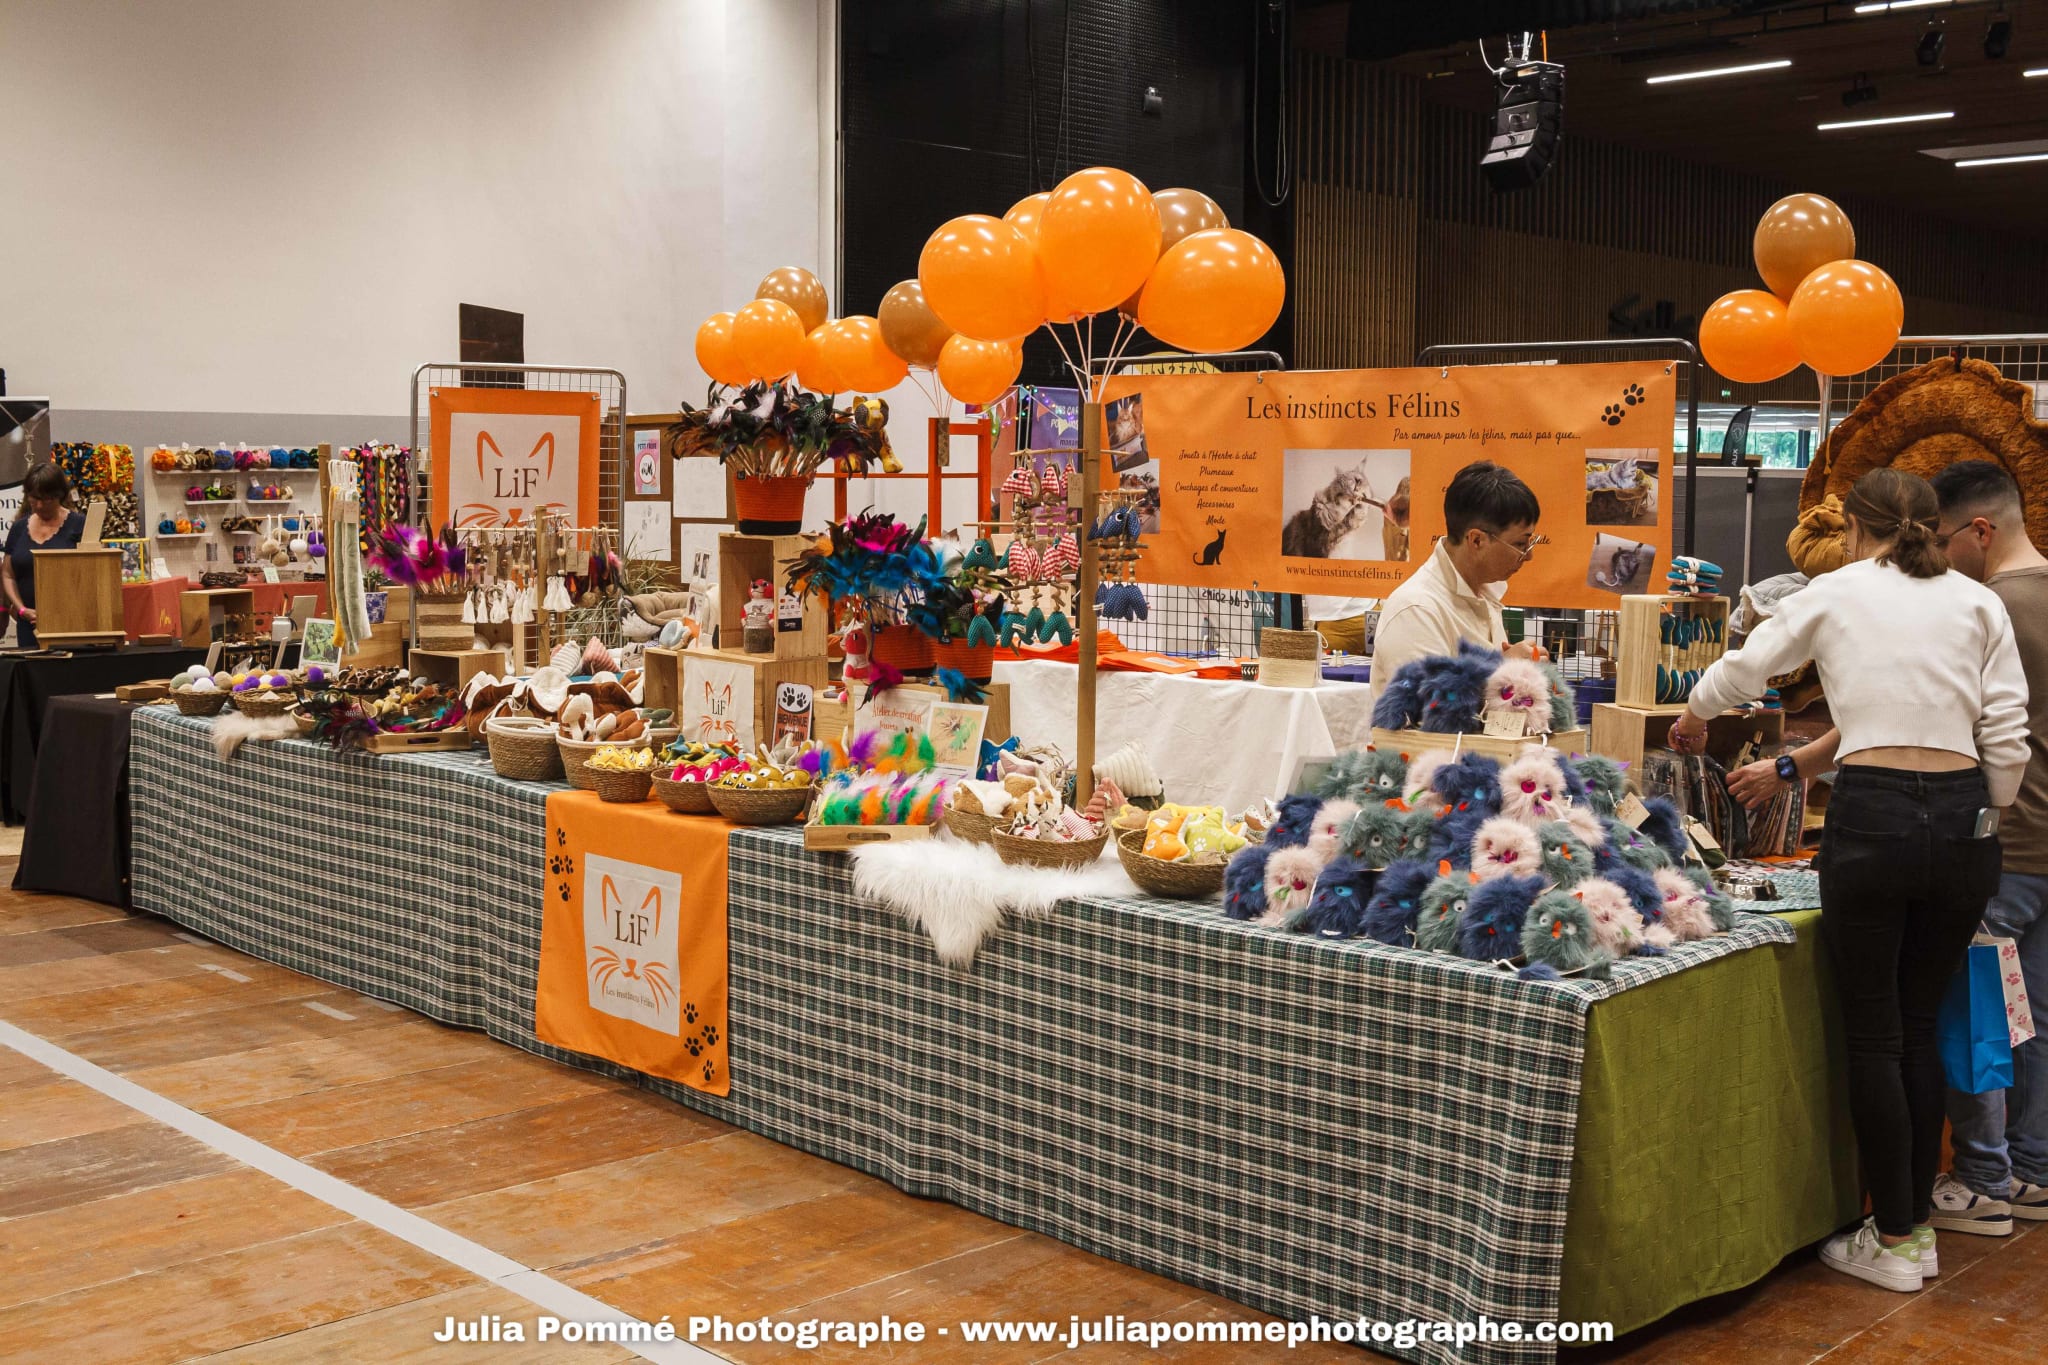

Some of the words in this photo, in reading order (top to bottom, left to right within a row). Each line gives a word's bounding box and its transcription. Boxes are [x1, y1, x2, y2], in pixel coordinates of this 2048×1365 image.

[1246, 396, 1282, 419] Les
[1286, 394, 1377, 419] instincts
[1387, 392, 1461, 418] Félins
[1393, 428, 1409, 441] Par
[1412, 432, 1441, 440] amour
[1444, 432, 1466, 444] pour
[1469, 429, 1479, 440] les
[1510, 430, 1532, 440] mais
[1535, 432, 1552, 444] pas
[1178, 450, 1200, 460] Jouets
[1242, 451, 1257, 460] chat
[1199, 466, 1234, 476] Plumeaux
[494, 468, 541, 499] LiF
[1175, 481, 1209, 496] Couchages
[1211, 483, 1218, 492] et
[1220, 484, 1259, 493] couvertures
[1196, 498, 1235, 509] Accessoires
[1206, 515, 1225, 525] Mode
[1286, 565, 1404, 580] www.lesinstinctsfélins.fr
[712, 698, 727, 716] LiF
[615, 909, 649, 947] LiF
